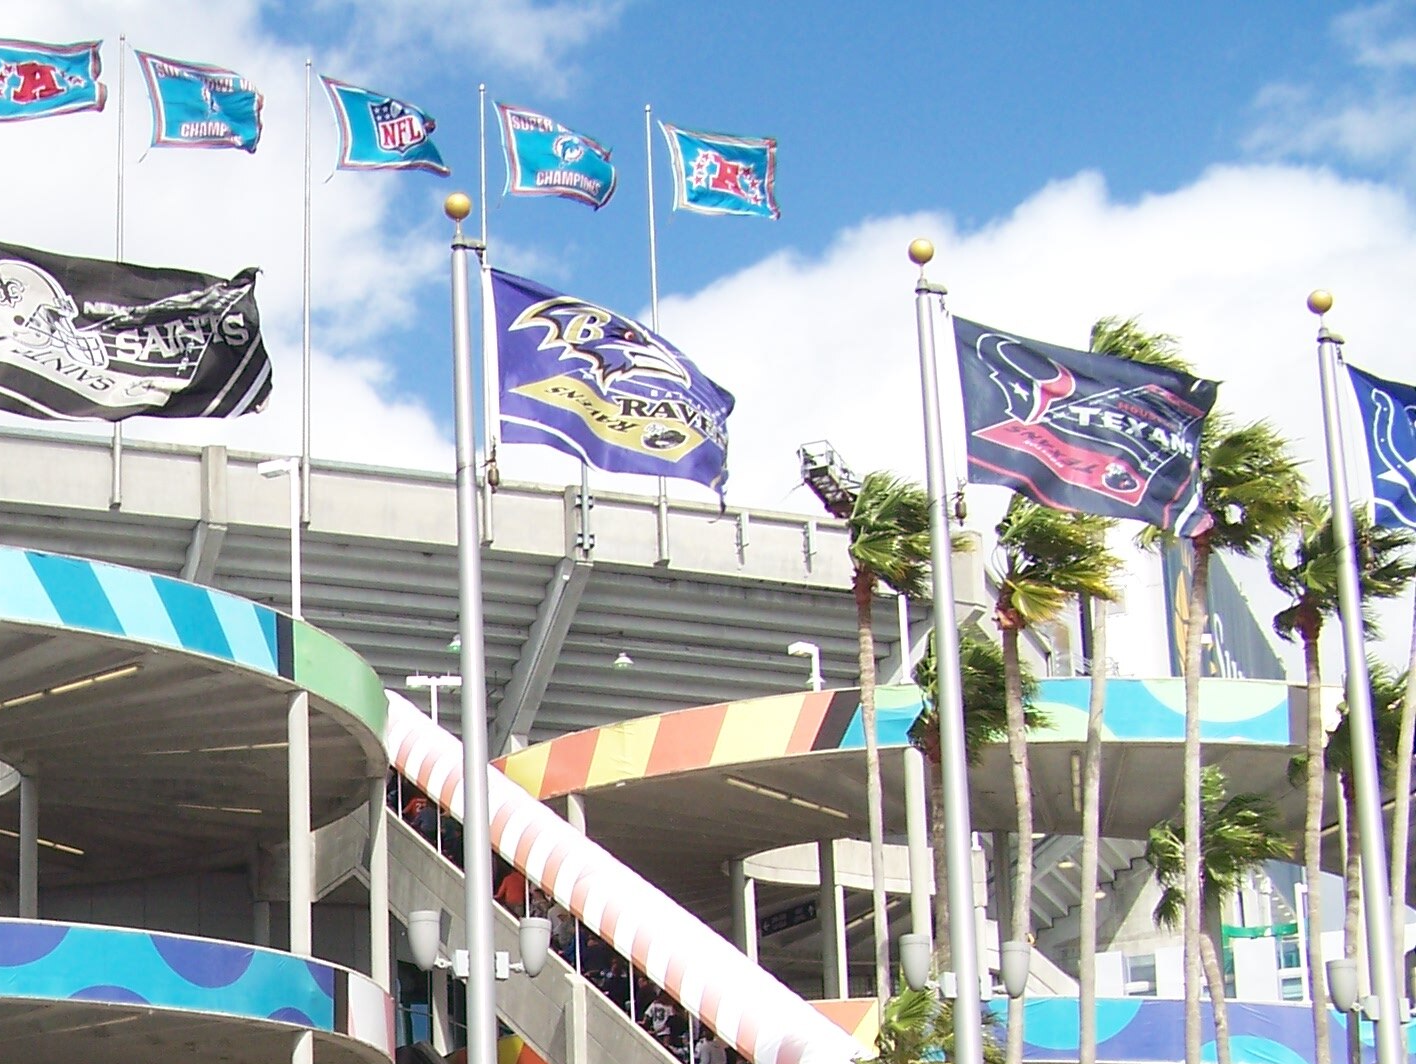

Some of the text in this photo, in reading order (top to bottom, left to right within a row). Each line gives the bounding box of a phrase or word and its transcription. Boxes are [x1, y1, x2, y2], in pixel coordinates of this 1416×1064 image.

[379, 113, 422, 151] NFL
[511, 114, 554, 132] SUPER
[115, 313, 250, 361] SAINTS
[563, 307, 612, 345] B
[1068, 405, 1194, 459] TEXANS
